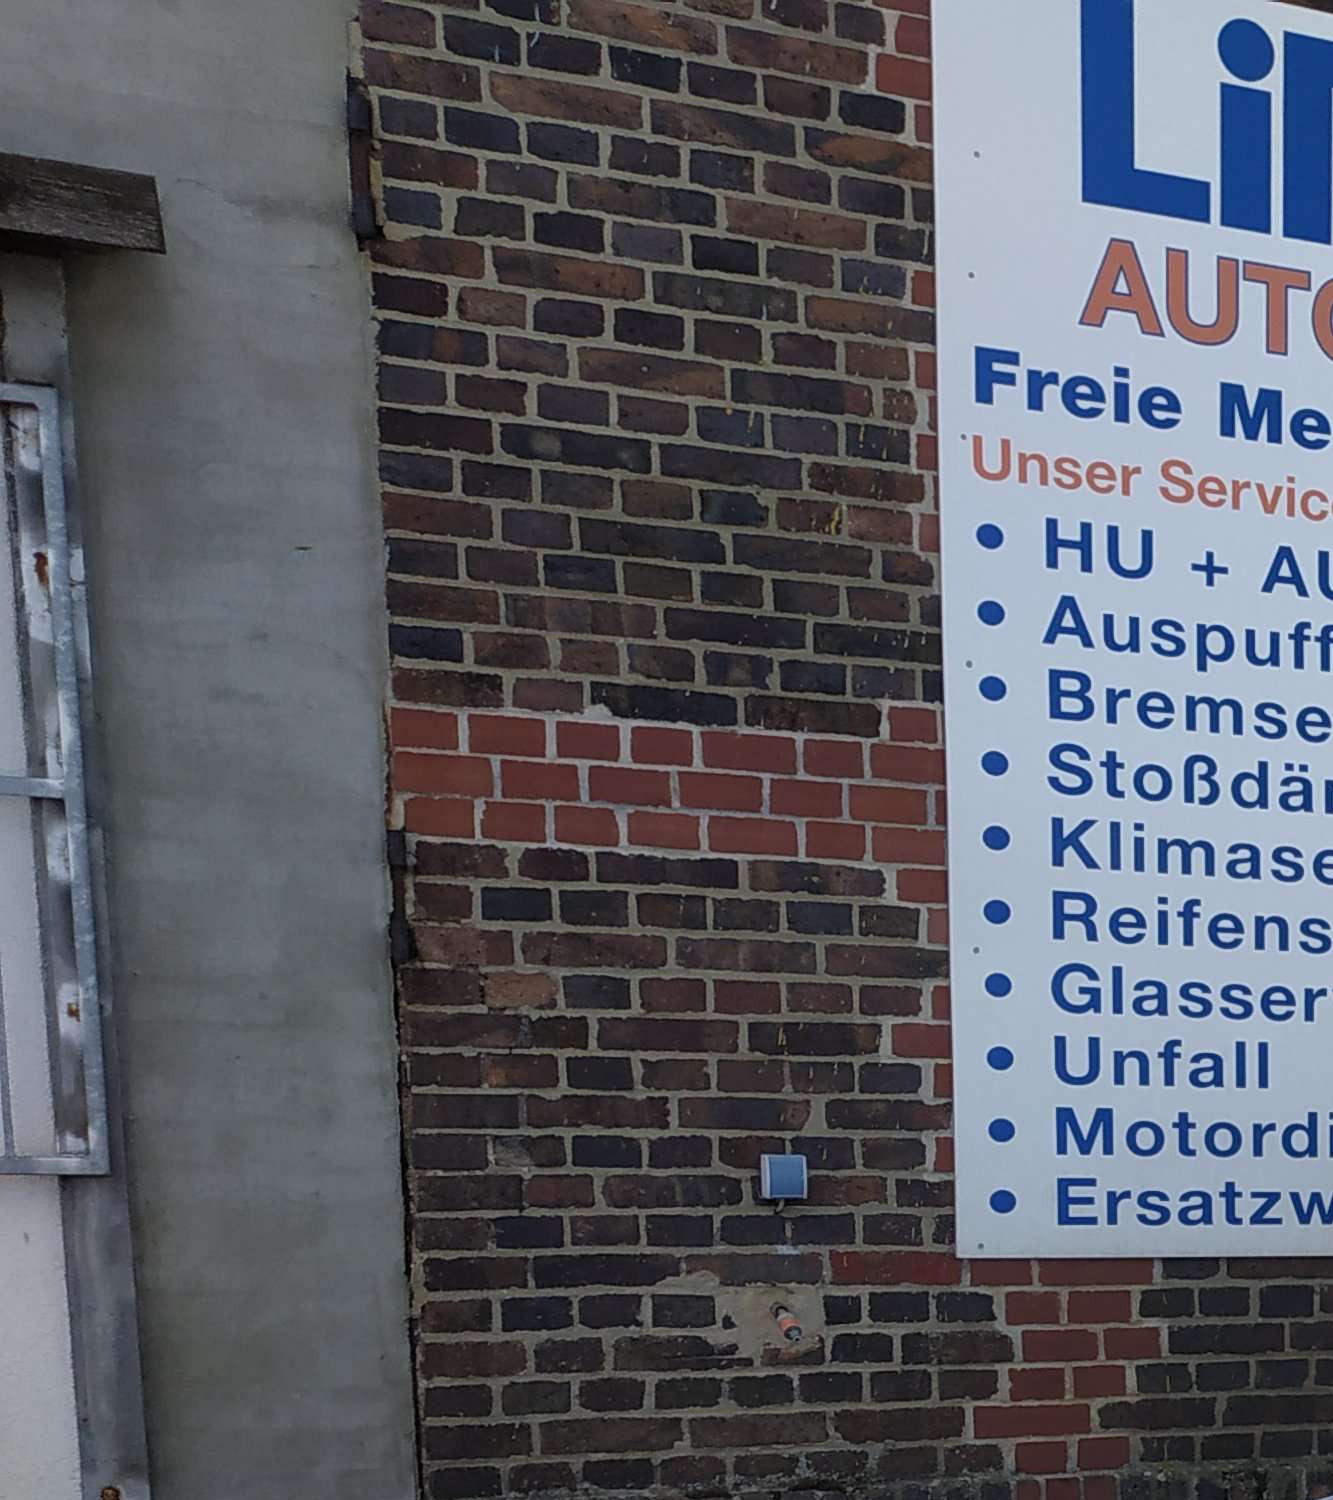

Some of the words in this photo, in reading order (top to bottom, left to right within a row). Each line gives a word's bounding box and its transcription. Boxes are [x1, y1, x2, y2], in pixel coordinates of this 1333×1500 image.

[974, 346, 1182, 430] Freie
[971, 435, 1141, 497] Unser
[1045, 517, 1154, 580] HU
[1191, 550, 1229, 587] +
[1053, 1035, 1271, 1091] Unfall
